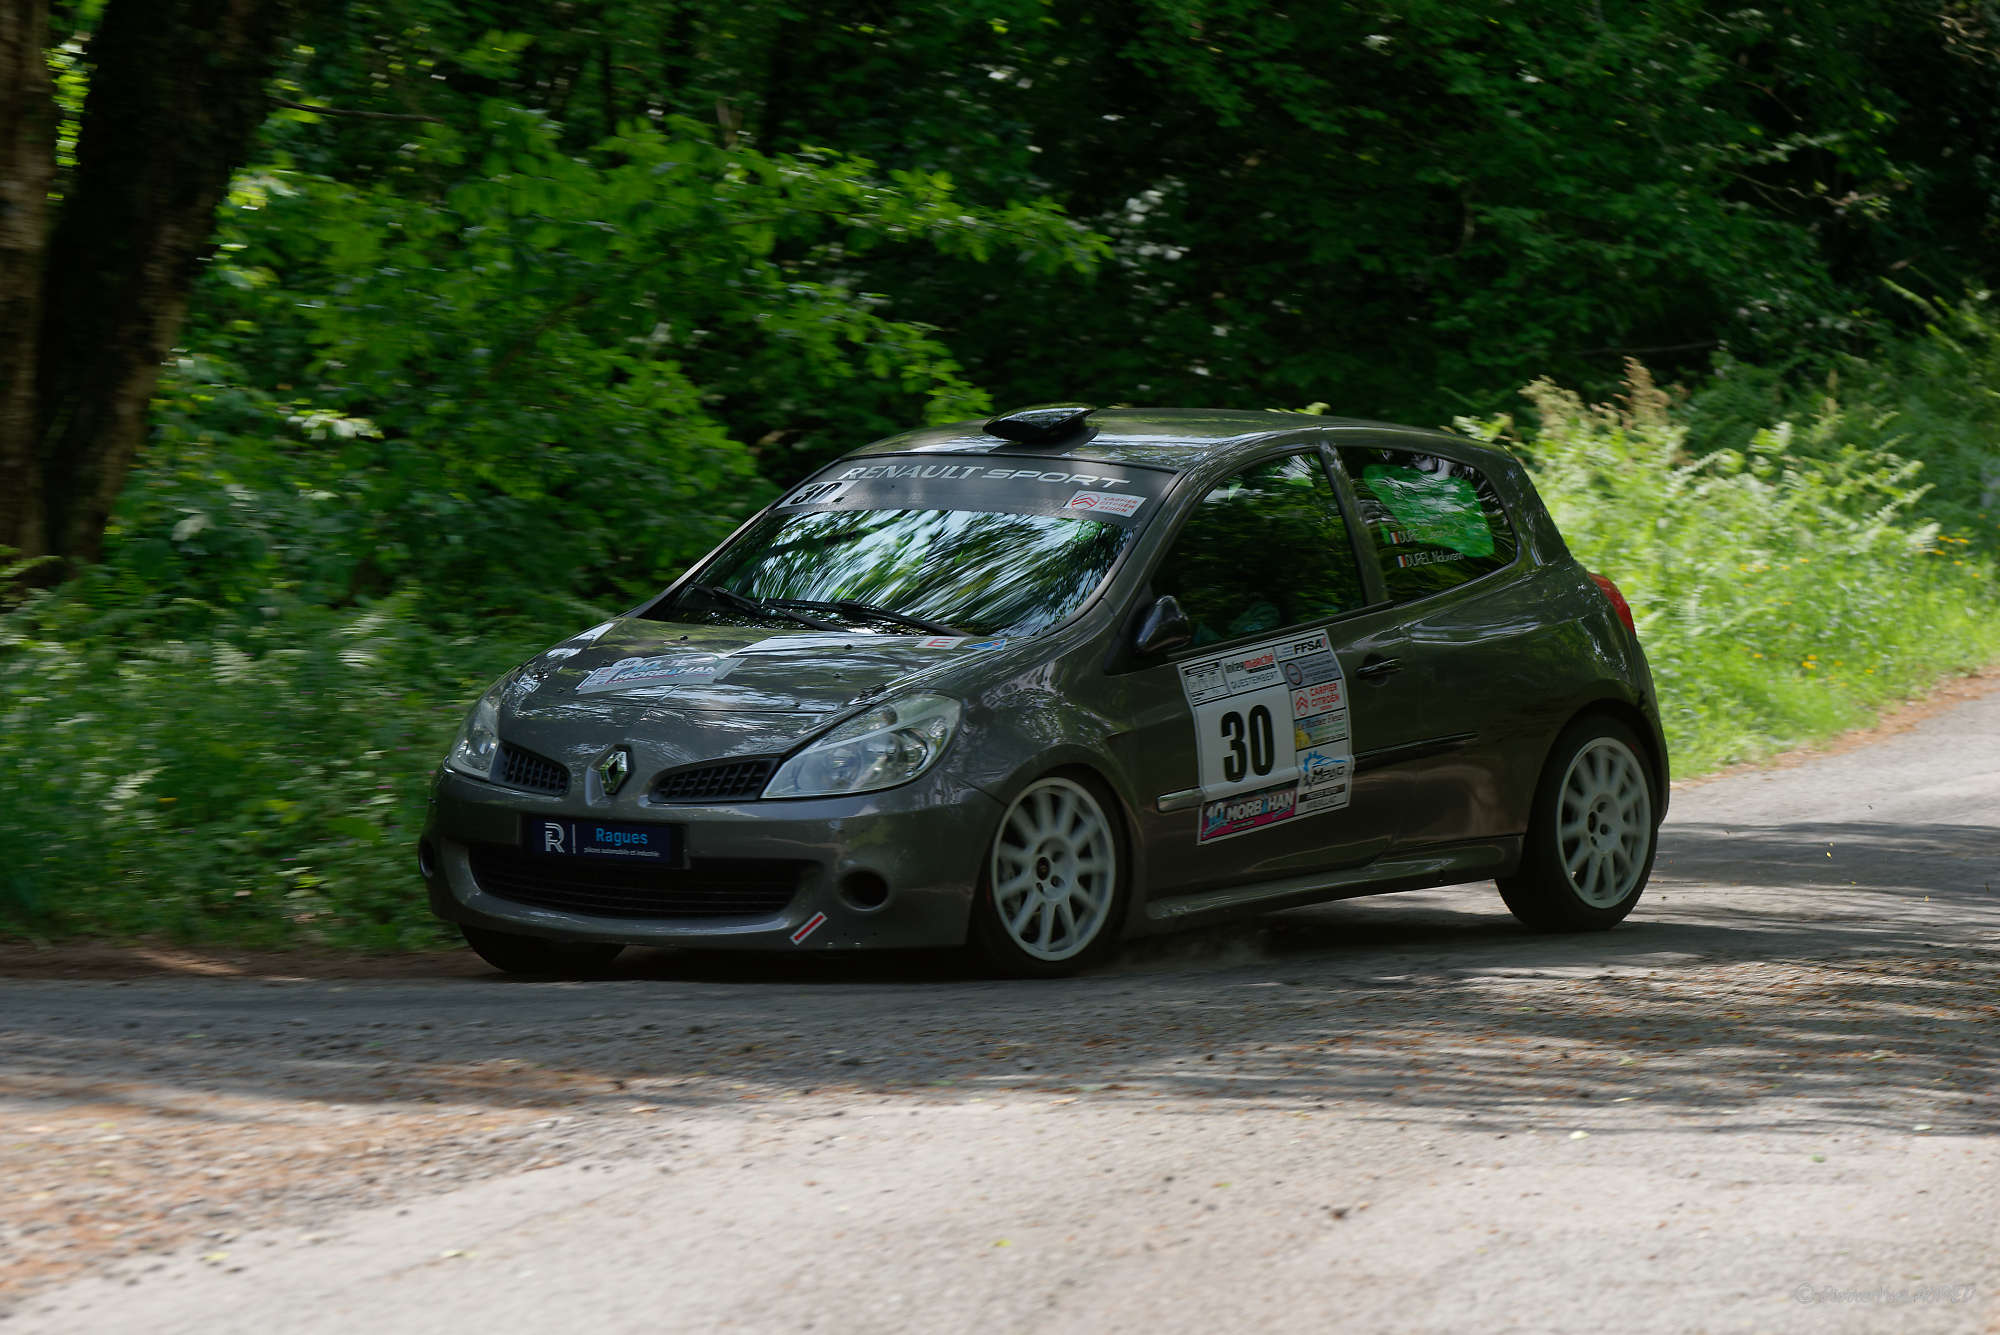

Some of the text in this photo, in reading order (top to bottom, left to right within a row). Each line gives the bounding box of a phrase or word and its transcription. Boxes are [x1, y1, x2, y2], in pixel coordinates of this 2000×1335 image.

[838, 465, 1132, 488] RENAULT SPORT
[789, 482, 843, 504] 30
[1294, 637, 1323, 655] FFSA
[1221, 704, 1275, 783] 30
[595, 827, 648, 846] Ragues
